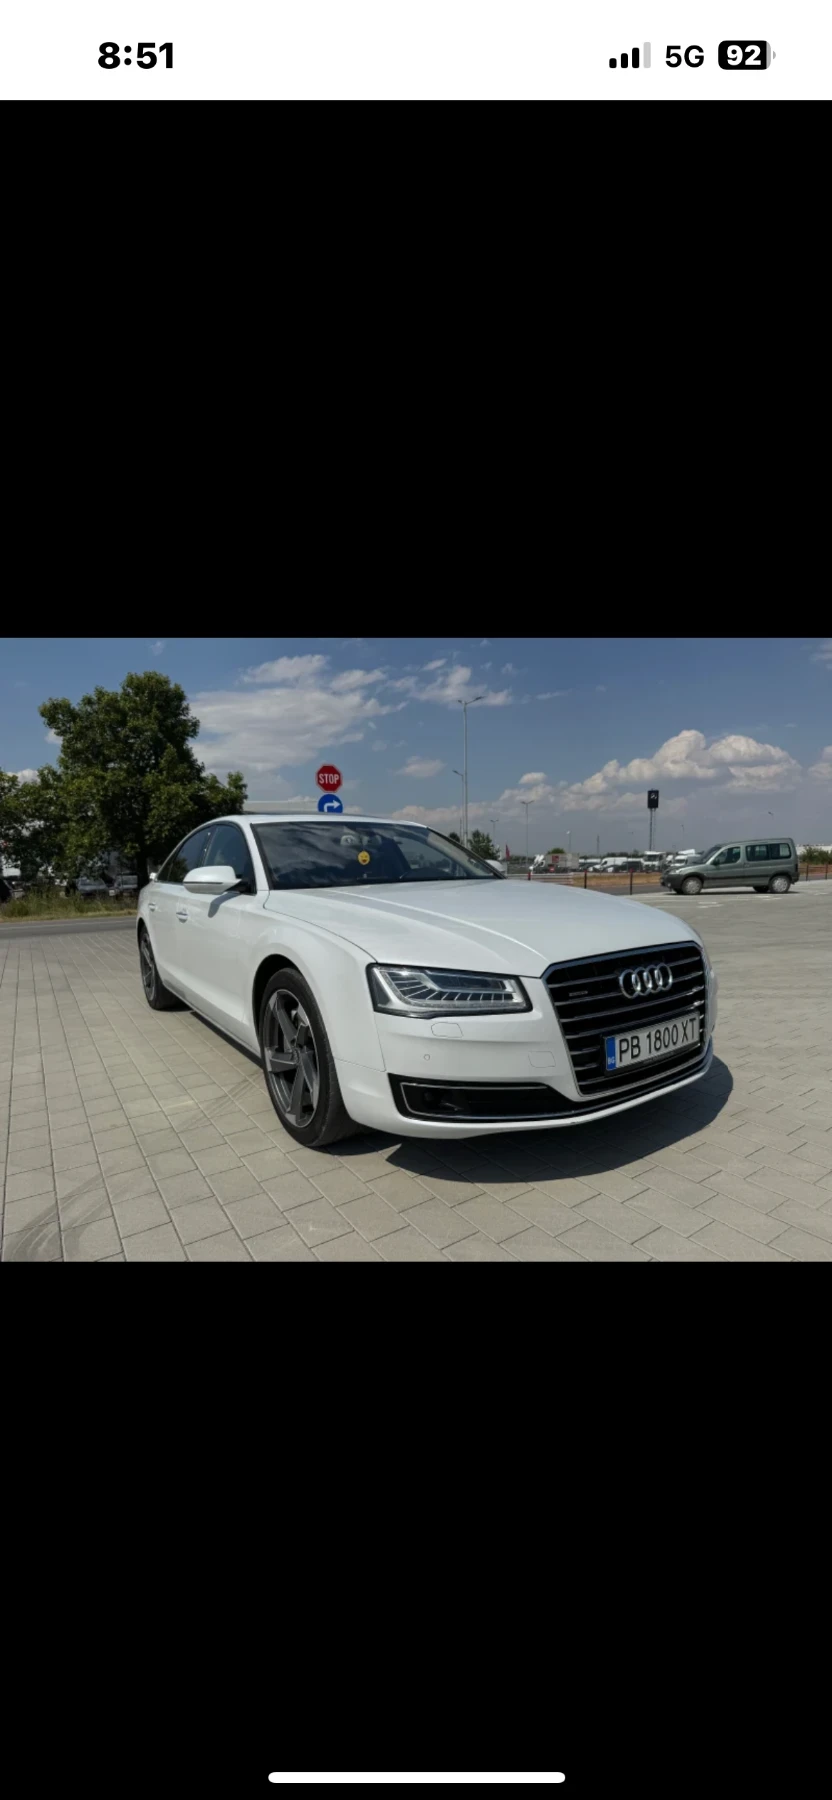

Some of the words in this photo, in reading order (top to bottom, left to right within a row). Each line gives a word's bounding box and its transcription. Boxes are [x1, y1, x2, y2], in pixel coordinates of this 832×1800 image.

[319, 773, 340, 785] STOP
[618, 1035, 641, 1063] PB
[646, 1023, 679, 1054] 1800
[681, 1017, 697, 1044] XT
